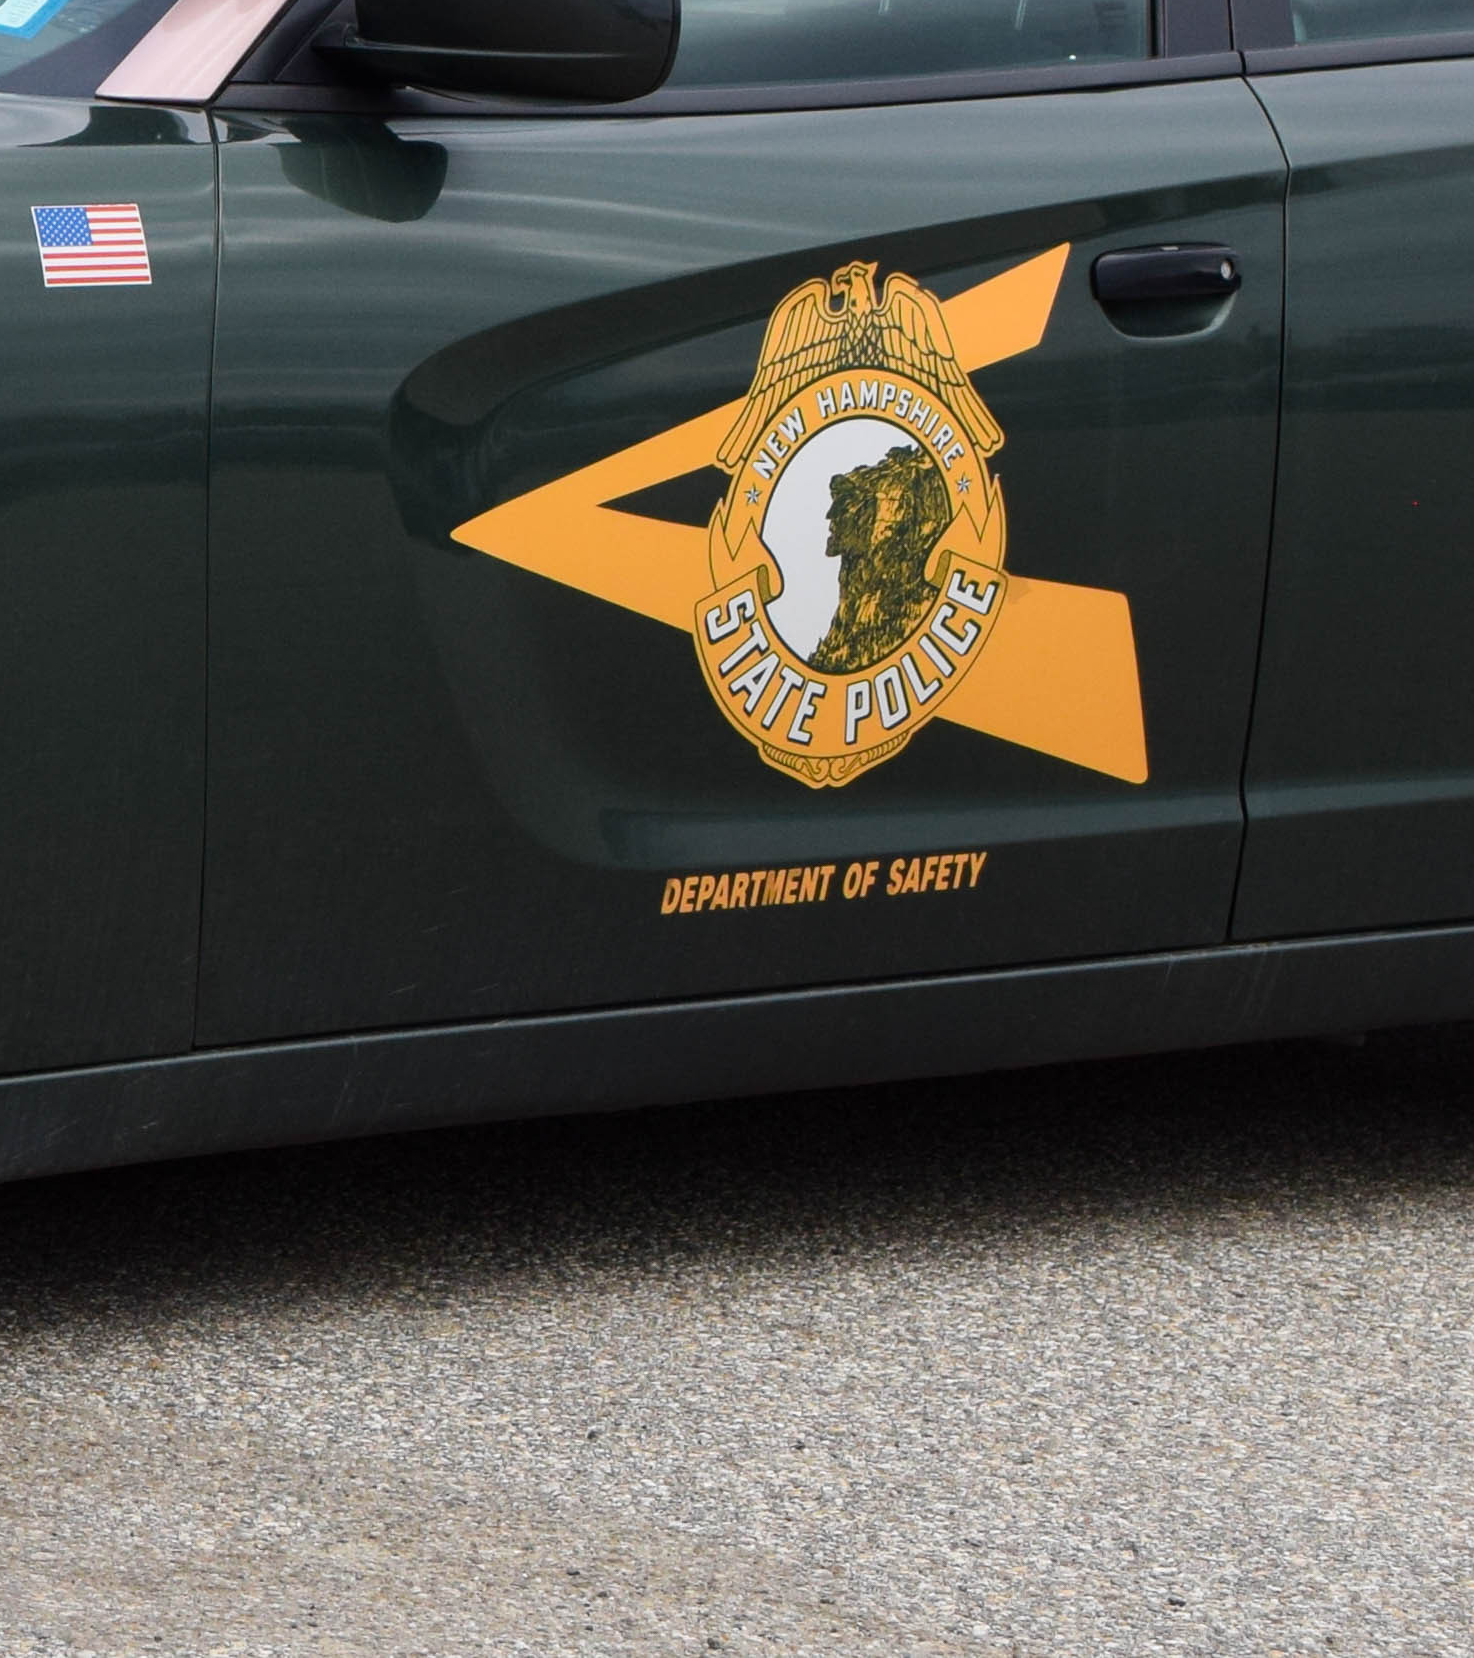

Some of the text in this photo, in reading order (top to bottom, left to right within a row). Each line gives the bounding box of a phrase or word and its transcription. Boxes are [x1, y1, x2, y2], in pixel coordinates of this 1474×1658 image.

[752, 380, 965, 481] NEW HAMPSHIRE
[705, 567, 1000, 745] STATE POLICE
[660, 851, 988, 915] DEPARTMENT OF SAFETY
